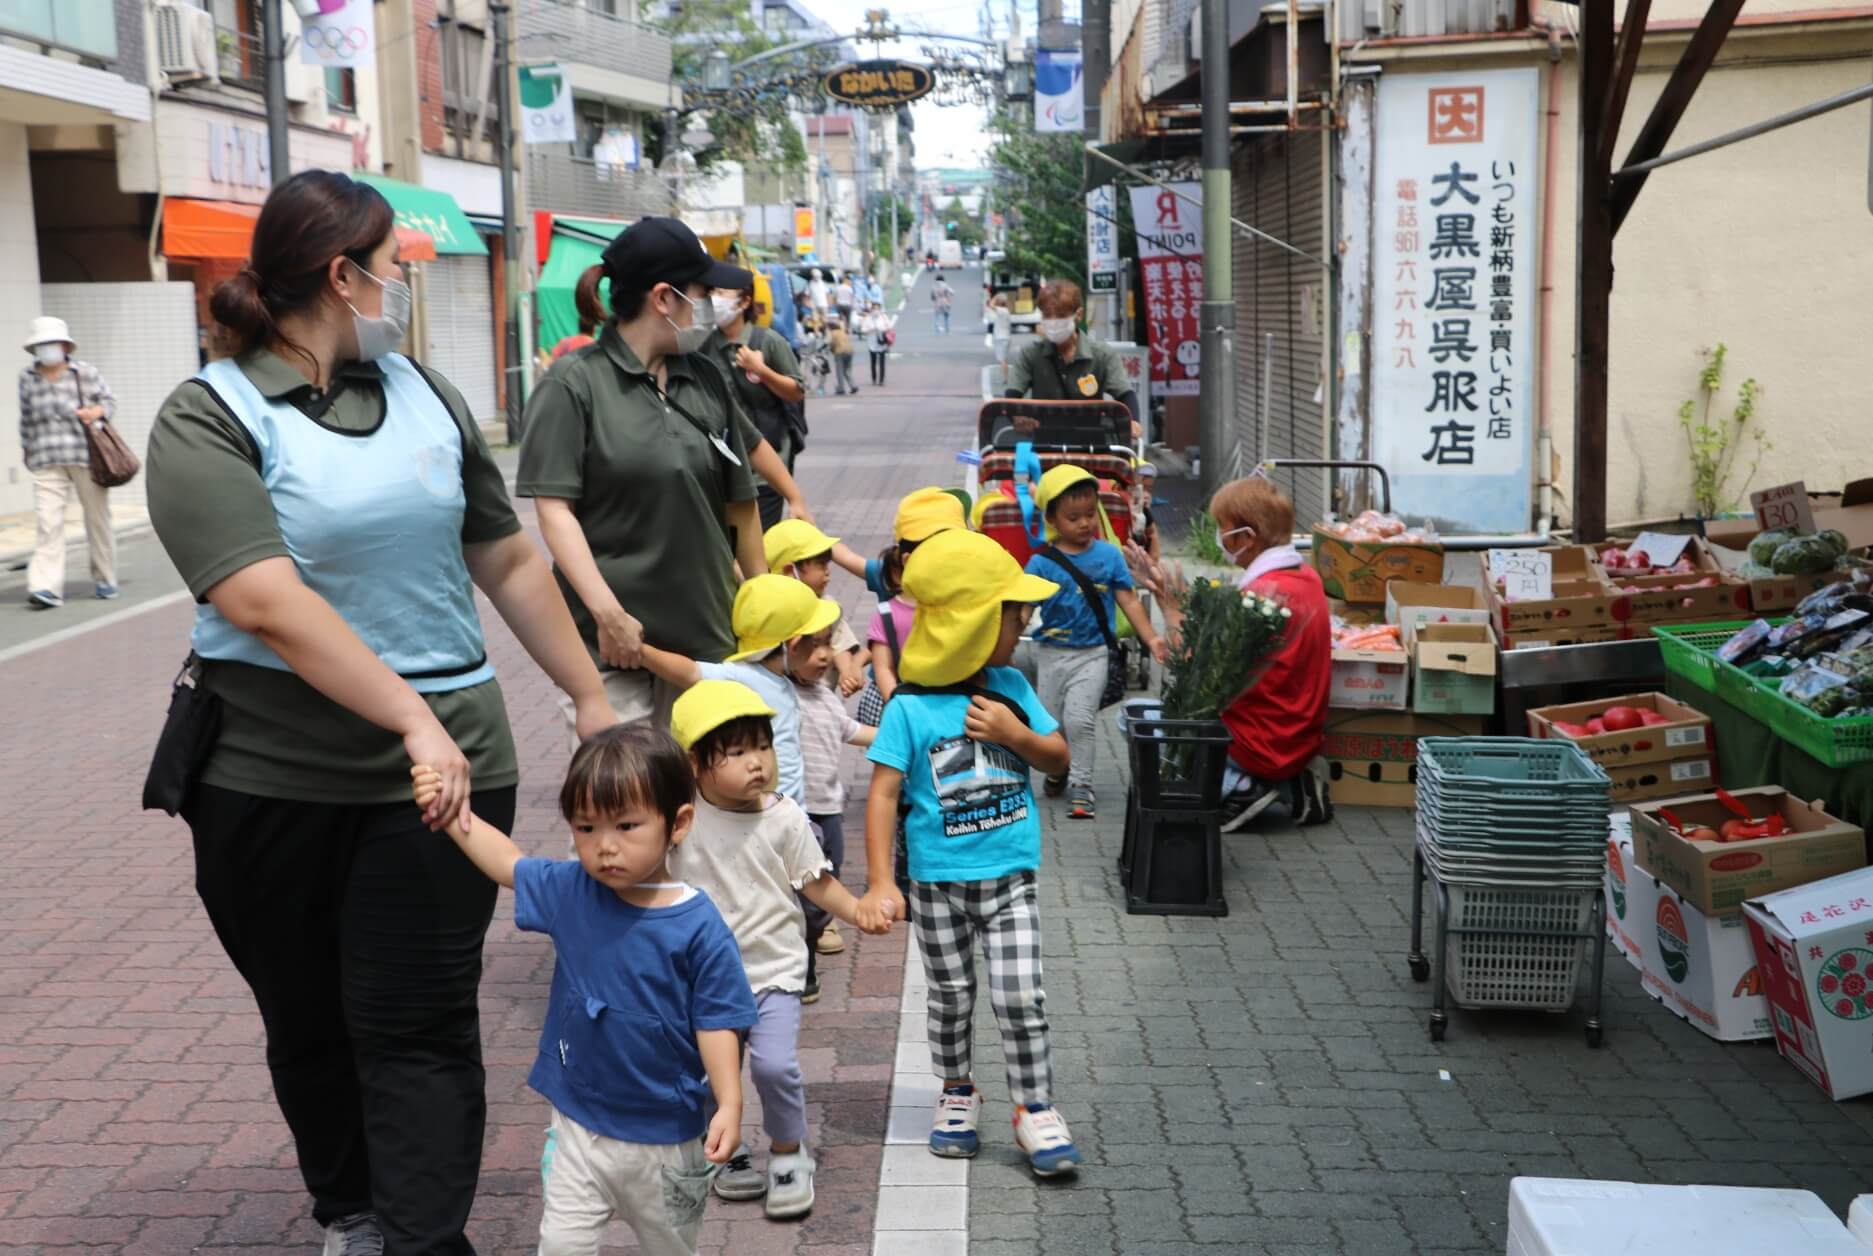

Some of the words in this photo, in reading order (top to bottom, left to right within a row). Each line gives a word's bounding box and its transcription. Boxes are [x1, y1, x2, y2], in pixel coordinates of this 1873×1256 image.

[841, 70, 915, 94] なかいた
[1487, 160, 1515, 439] いつも新柄豊富・買いよい店
[1422, 161, 1480, 465] 大黒屋呉服店
[1505, 560, 1548, 576] 250
[945, 806, 997, 824] Series
[945, 823, 978, 836] Keihin
